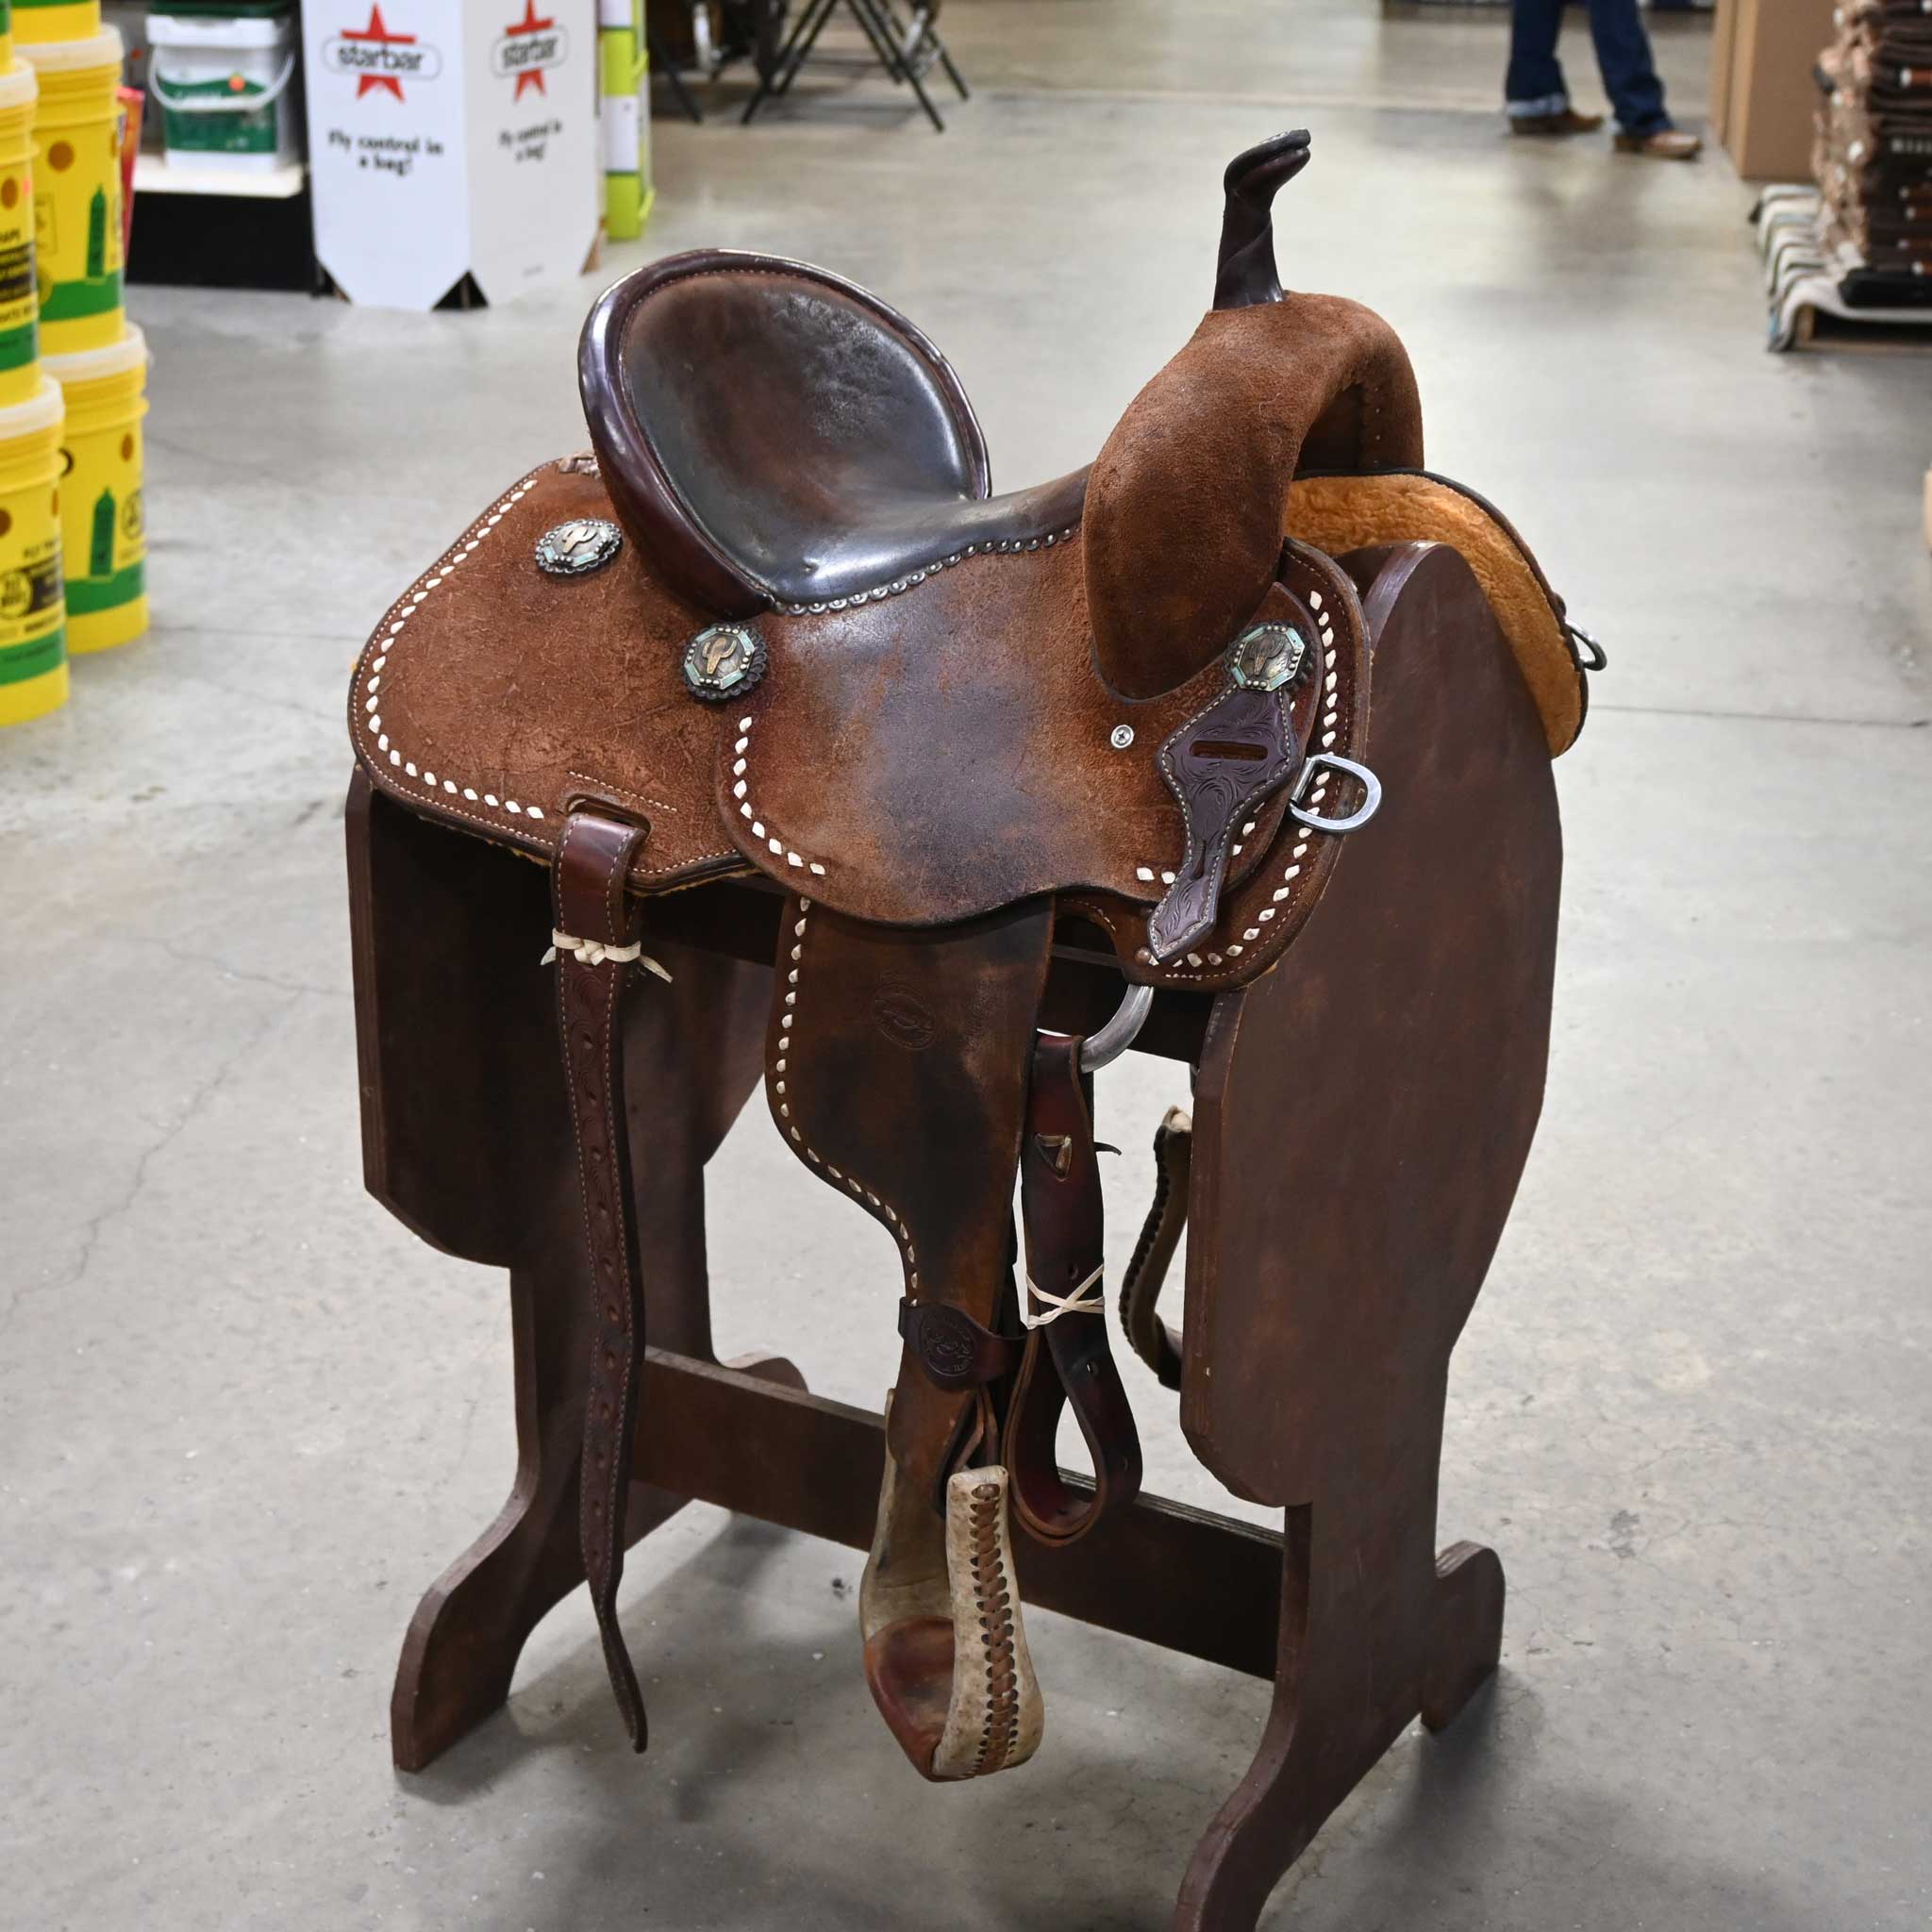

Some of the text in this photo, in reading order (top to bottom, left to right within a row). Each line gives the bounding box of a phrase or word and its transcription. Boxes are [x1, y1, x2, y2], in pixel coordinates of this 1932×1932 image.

[338, 43, 423, 70] starbar
[328, 130, 443, 155] Fly control in
